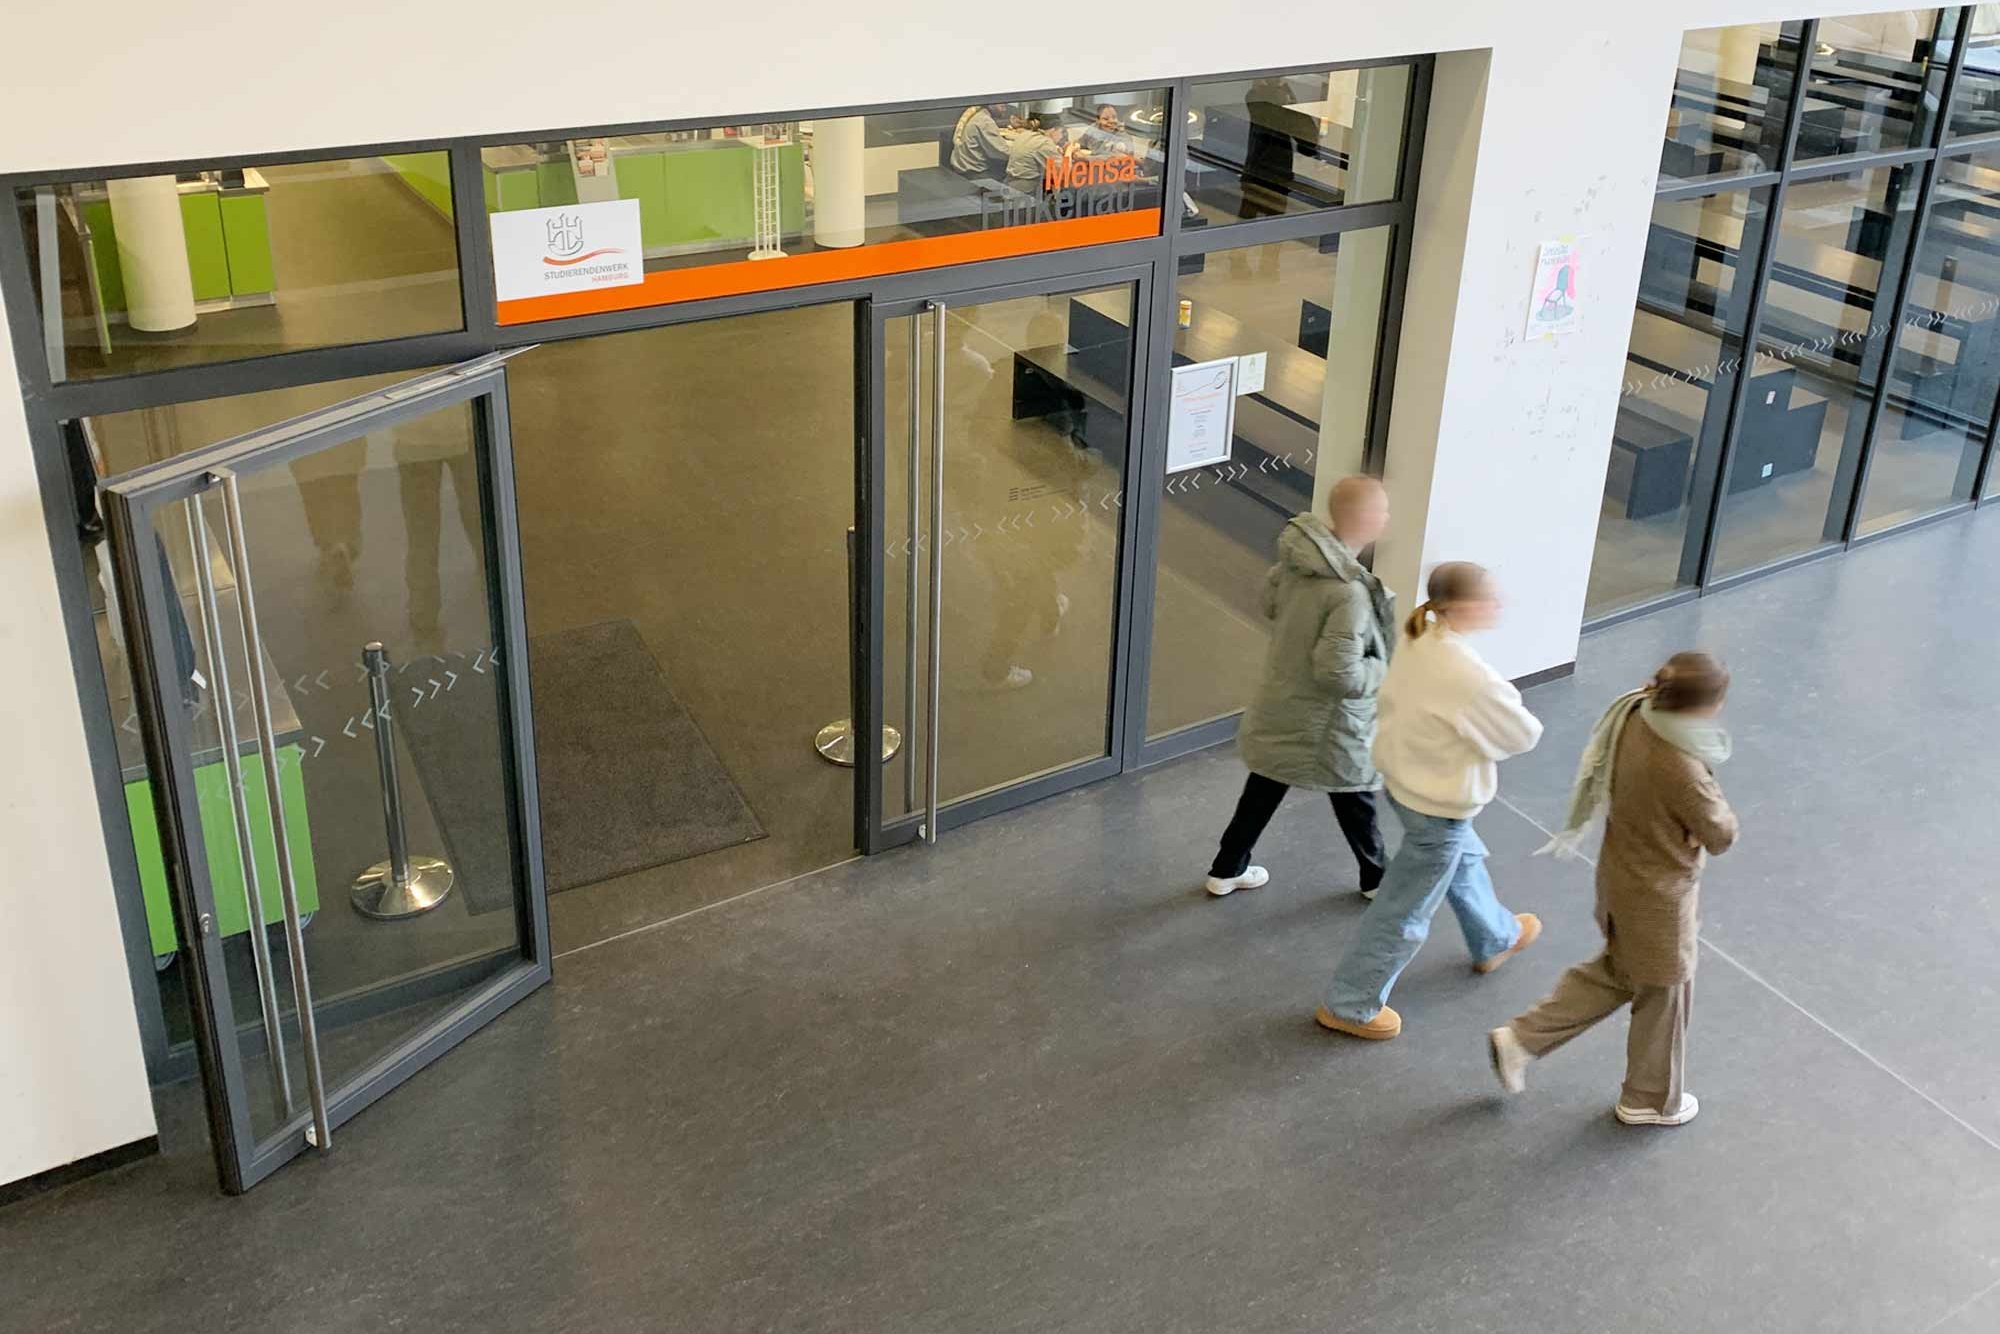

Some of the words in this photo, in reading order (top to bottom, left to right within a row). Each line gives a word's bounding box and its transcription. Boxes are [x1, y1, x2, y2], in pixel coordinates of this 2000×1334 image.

[1045, 155, 1137, 190] Mensa
[981, 175, 1135, 230] Finkenau
[544, 263, 629, 281] STUDIERENDENWERK
[591, 272, 629, 283] HAMBURG
